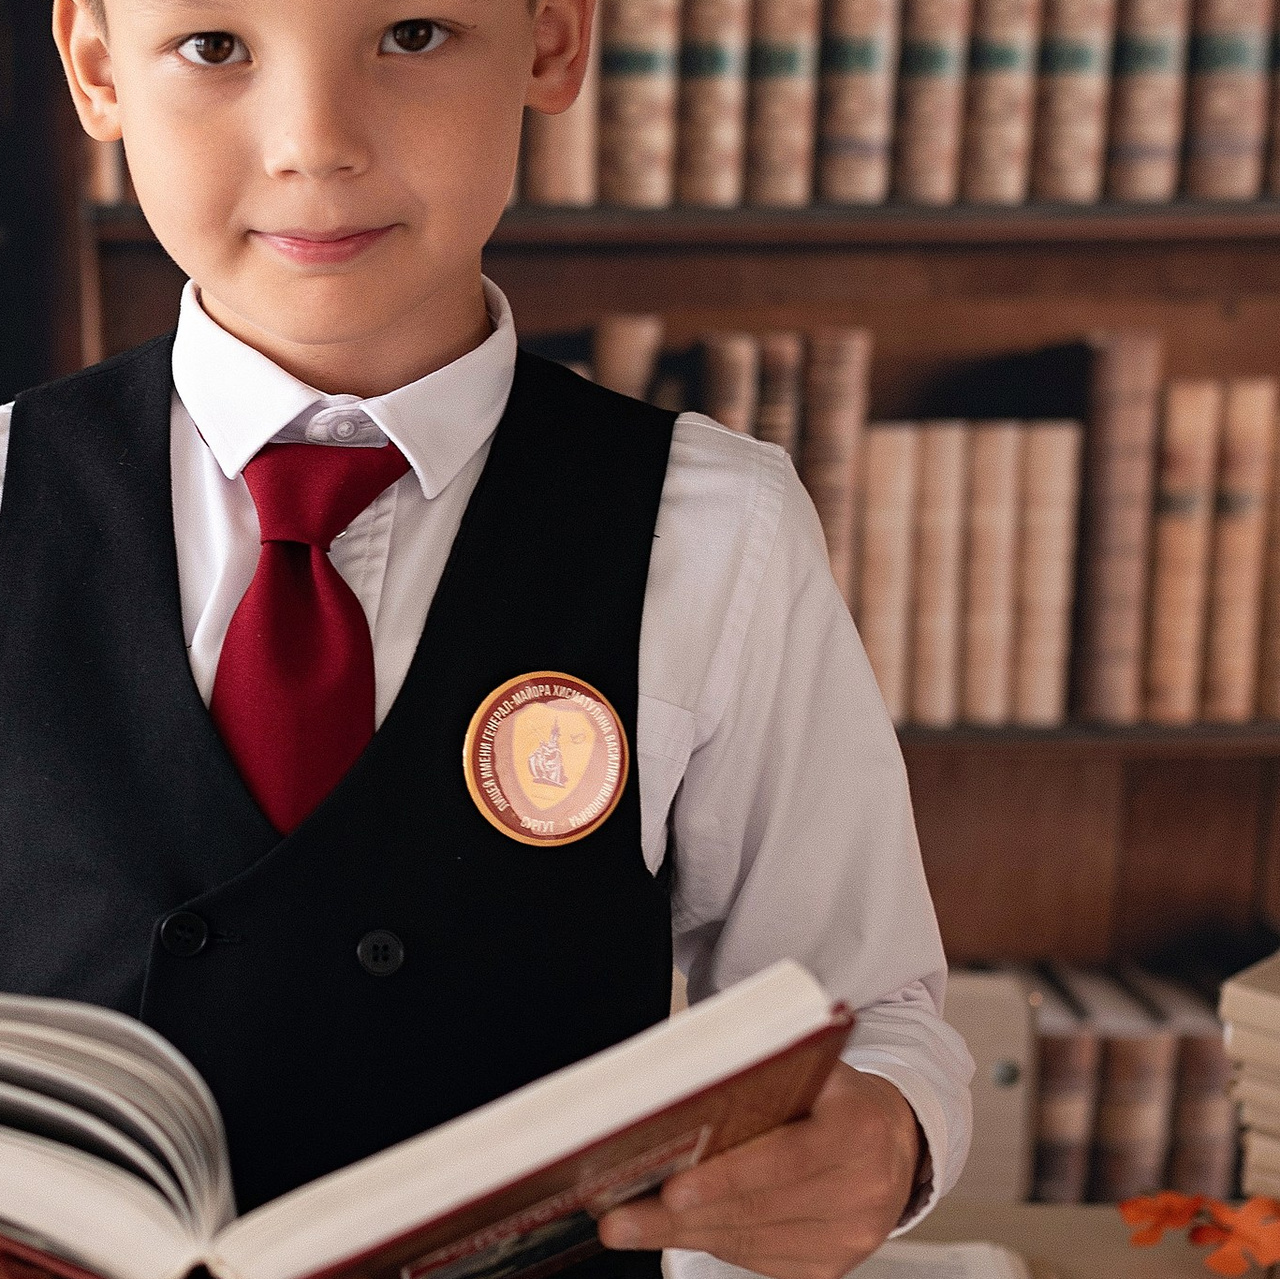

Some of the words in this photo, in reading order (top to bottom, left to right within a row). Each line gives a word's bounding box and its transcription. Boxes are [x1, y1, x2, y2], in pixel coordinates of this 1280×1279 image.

[483, 684, 552, 741] ГЕНЕРАЛ-МАЙОРА
[553, 684, 613, 735] ХИСМАТУЛИНА
[479, 744, 492, 778] ИМЕНИ
[604, 734, 620, 783] ВАСИЛИЯ
[482, 778, 510, 812] ЛИЦЕЙ
[569, 782, 614, 828] ИВАНОВИЧА
